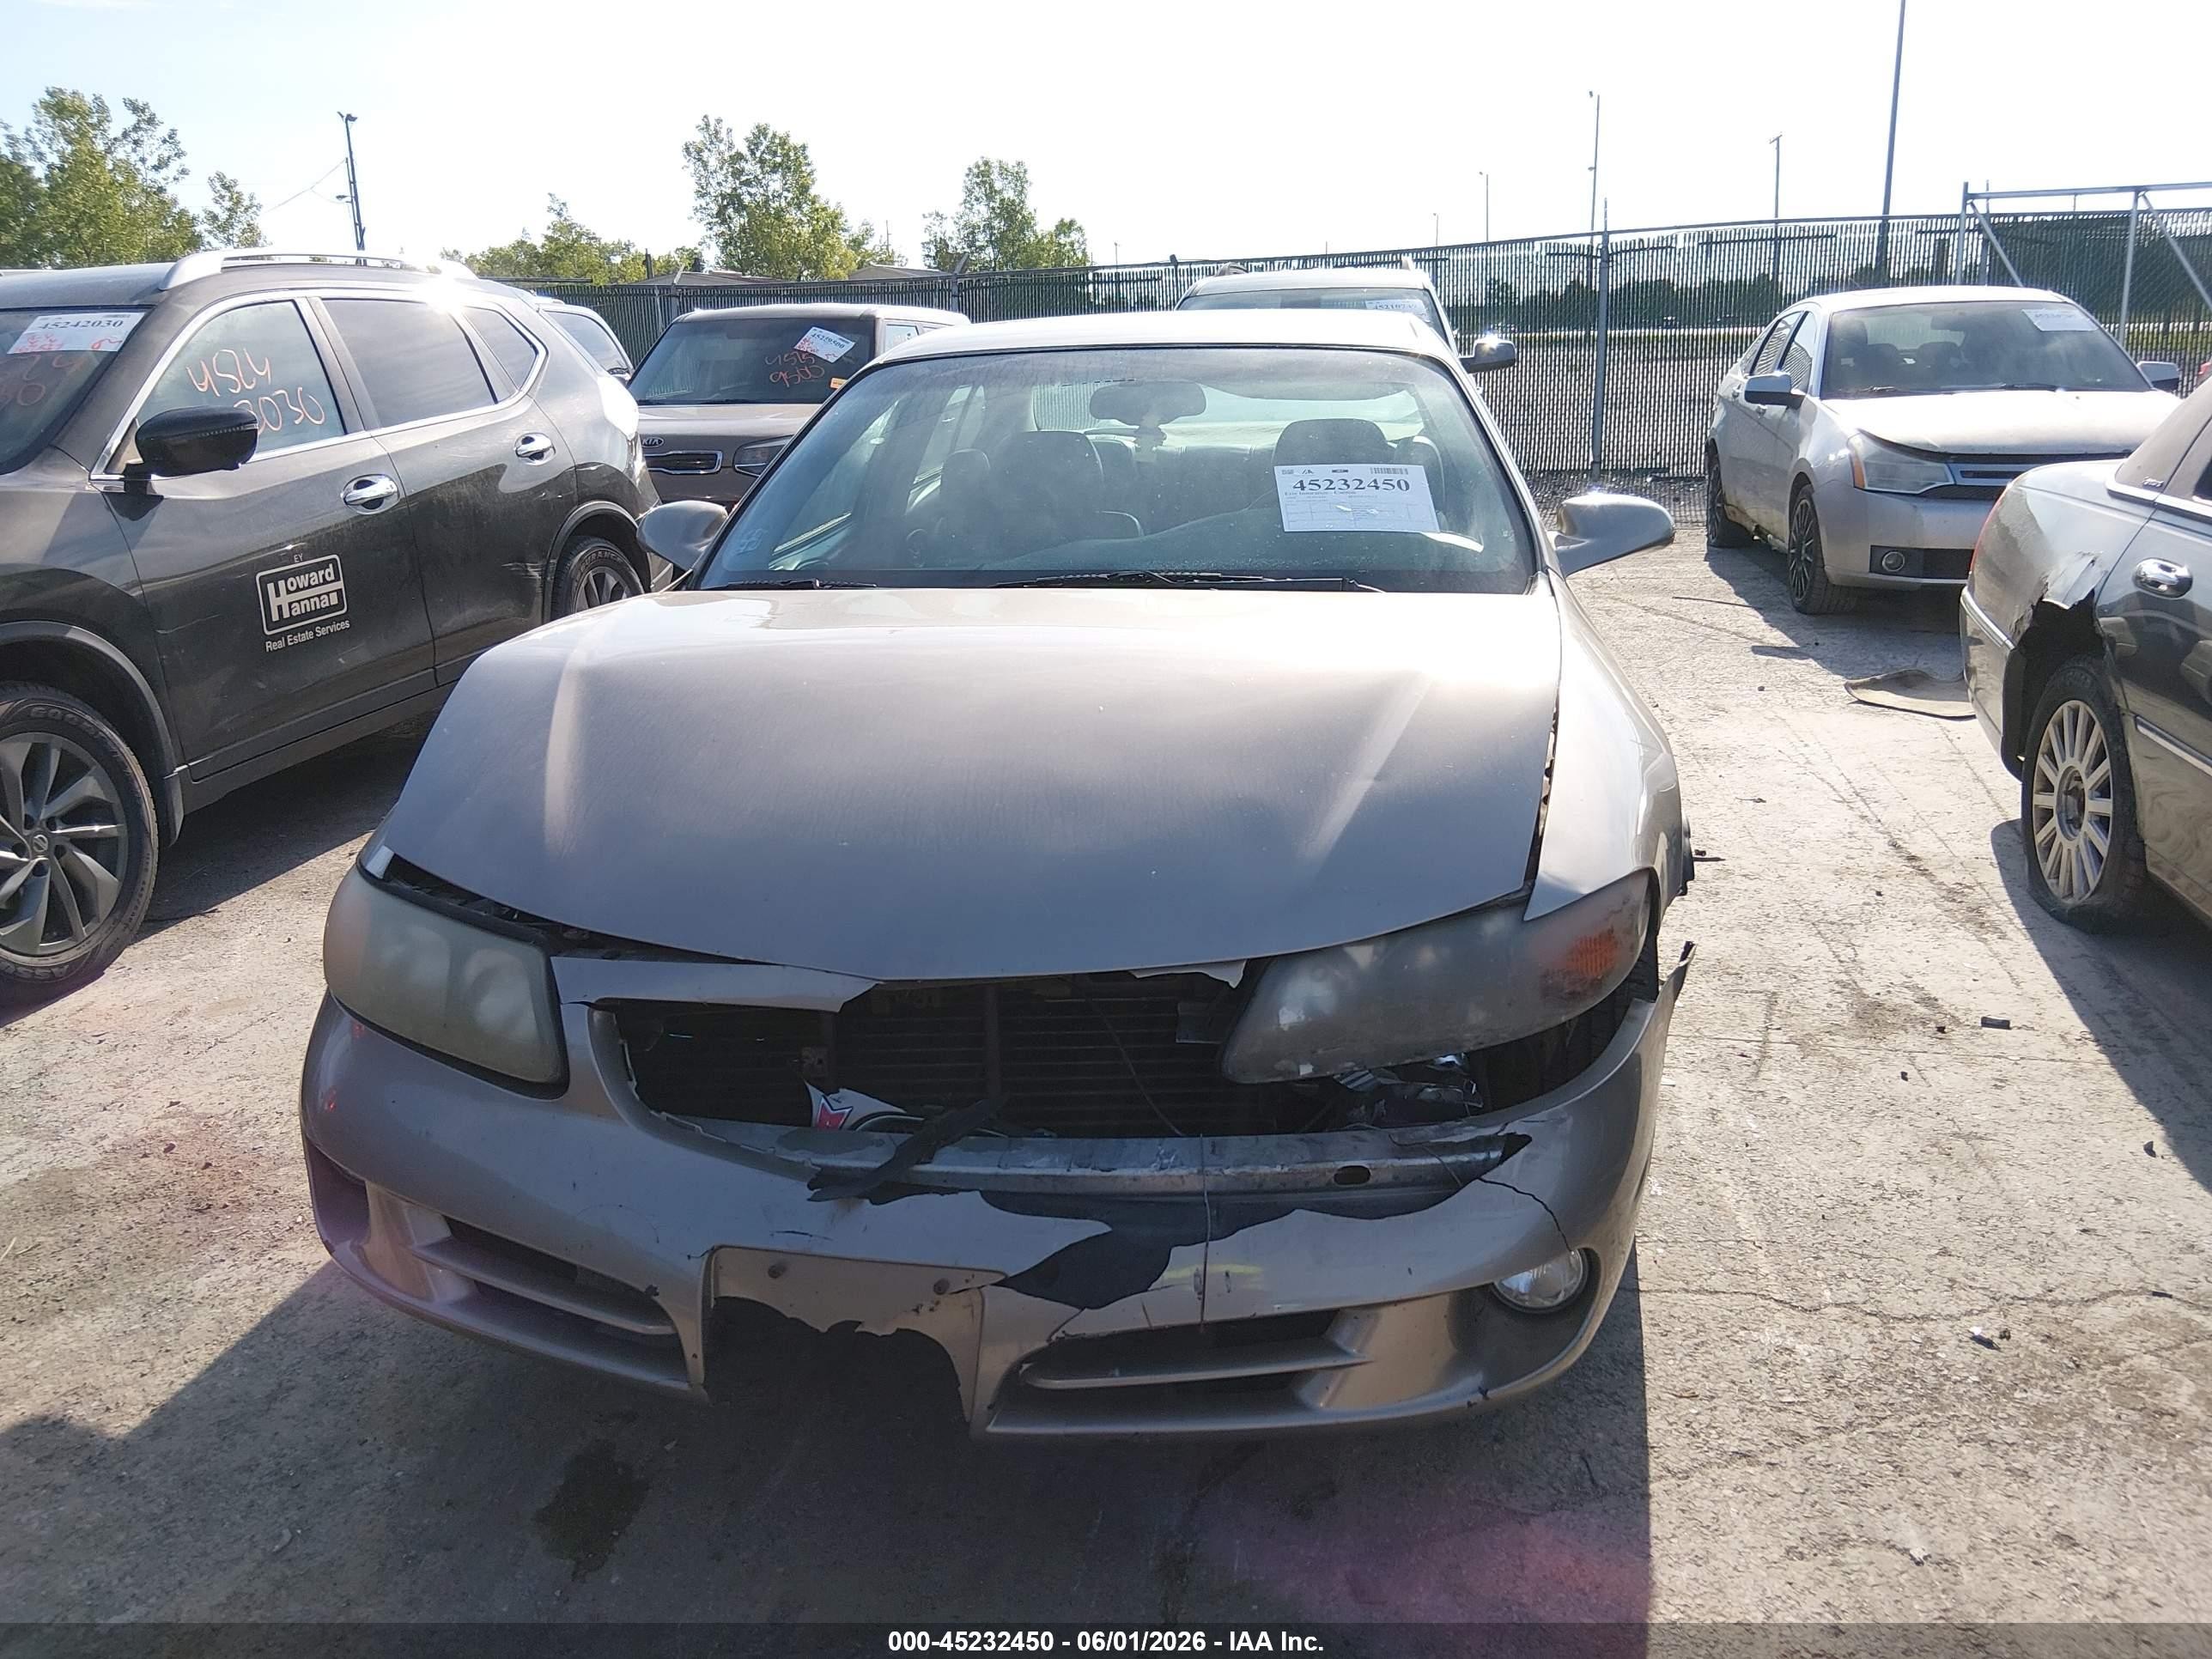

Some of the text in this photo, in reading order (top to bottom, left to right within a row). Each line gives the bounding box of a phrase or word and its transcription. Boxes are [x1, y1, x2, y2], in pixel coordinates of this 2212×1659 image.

[40, 319, 124, 330] 45242030
[1292, 478, 1410, 491] 45232450
[267, 563, 335, 604] Howard
[269, 590, 331, 622] Hanna
[265, 620, 350, 652] Real Estate Services
